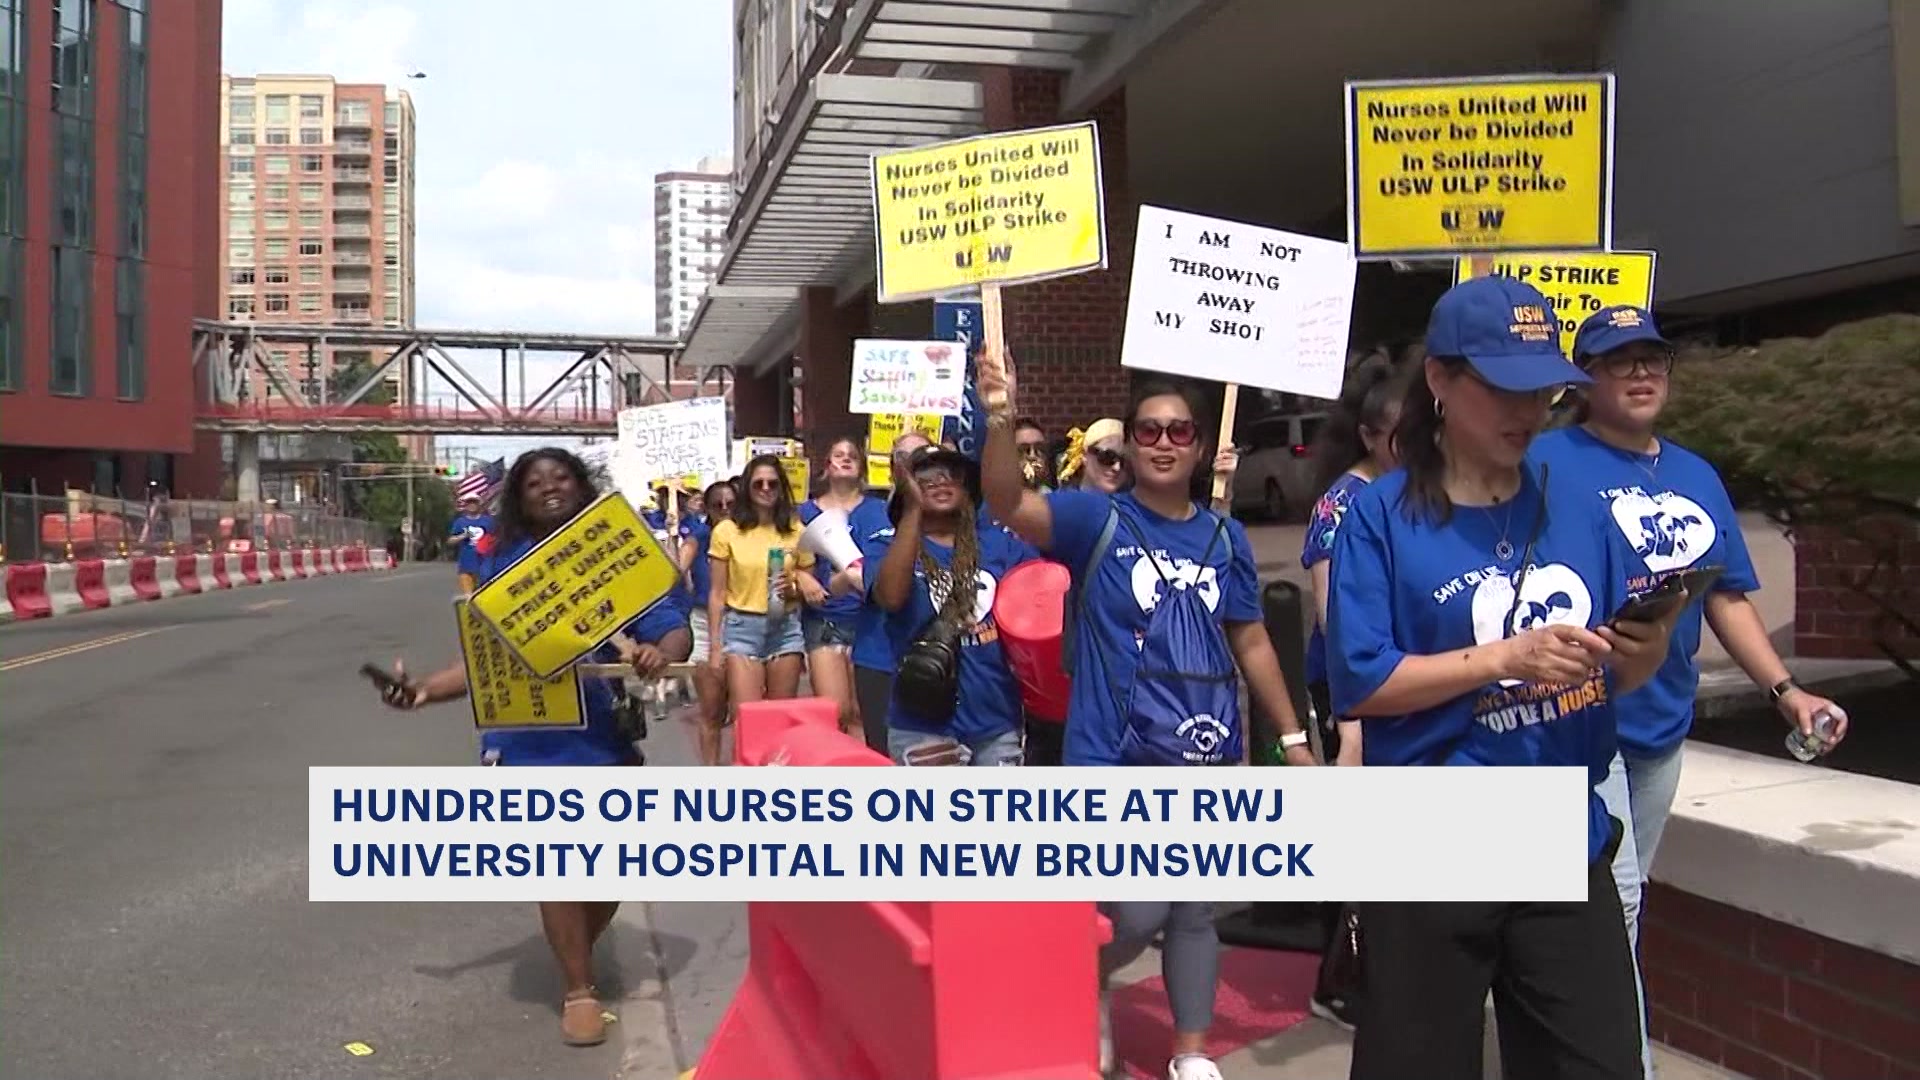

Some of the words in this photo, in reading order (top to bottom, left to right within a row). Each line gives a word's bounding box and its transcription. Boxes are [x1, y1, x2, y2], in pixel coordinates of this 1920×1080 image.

[1368, 100, 1450, 119] Nurses
[1458, 95, 1537, 116] United
[1545, 93, 1587, 113] Will
[1373, 125, 1441, 144] Never
[1450, 122, 1478, 141] be
[1486, 119, 1574, 139] Divided
[886, 157, 958, 181] Nurses
[965, 144, 1034, 168] United
[1041, 138, 1080, 158] Will
[1402, 154, 1424, 172] In
[1432, 149, 1543, 174] Solidarity
[891, 179, 952, 201] Never
[958, 173, 982, 190] be
[990, 160, 1070, 184] Divided
[1380, 176, 1433, 197] USW
[1443, 174, 1489, 194] ULP
[1498, 172, 1568, 193] Strike
[918, 206, 938, 222] In
[945, 190, 1045, 218] Solidarity
[899, 224, 947, 246] USW
[954, 215, 996, 237] ULP
[1003, 209, 1068, 230] Strike
[954, 244, 1013, 269] UW
[1165, 223, 1174, 239] I
[1199, 230, 1232, 248] AM
[1260, 242, 1302, 263] NOT
[1168, 257, 1280, 291] THROWING
[1540, 266, 1620, 285] STRIKE
[1197, 291, 1256, 314] AWAY
[1513, 305, 1546, 323] USW
[1546, 292, 1573, 310] air
[1579, 294, 1602, 312] To
[1153, 311, 1186, 330] MY
[1208, 318, 1265, 341] SHOT
[506, 566, 546, 599] RWJ
[545, 538, 585, 571] RNS
[583, 519, 612, 543] ON
[499, 580, 564, 632] STRIKE
[571, 528, 637, 578] UNFAIR
[1432, 577, 1466, 605] SAVE
[515, 601, 569, 647] LABOR
[569, 544, 650, 607] PRACTICE
[1475, 702, 1541, 735] YOU'RE
[1541, 700, 1558, 723] A
[1556, 678, 1608, 718] NUSE
